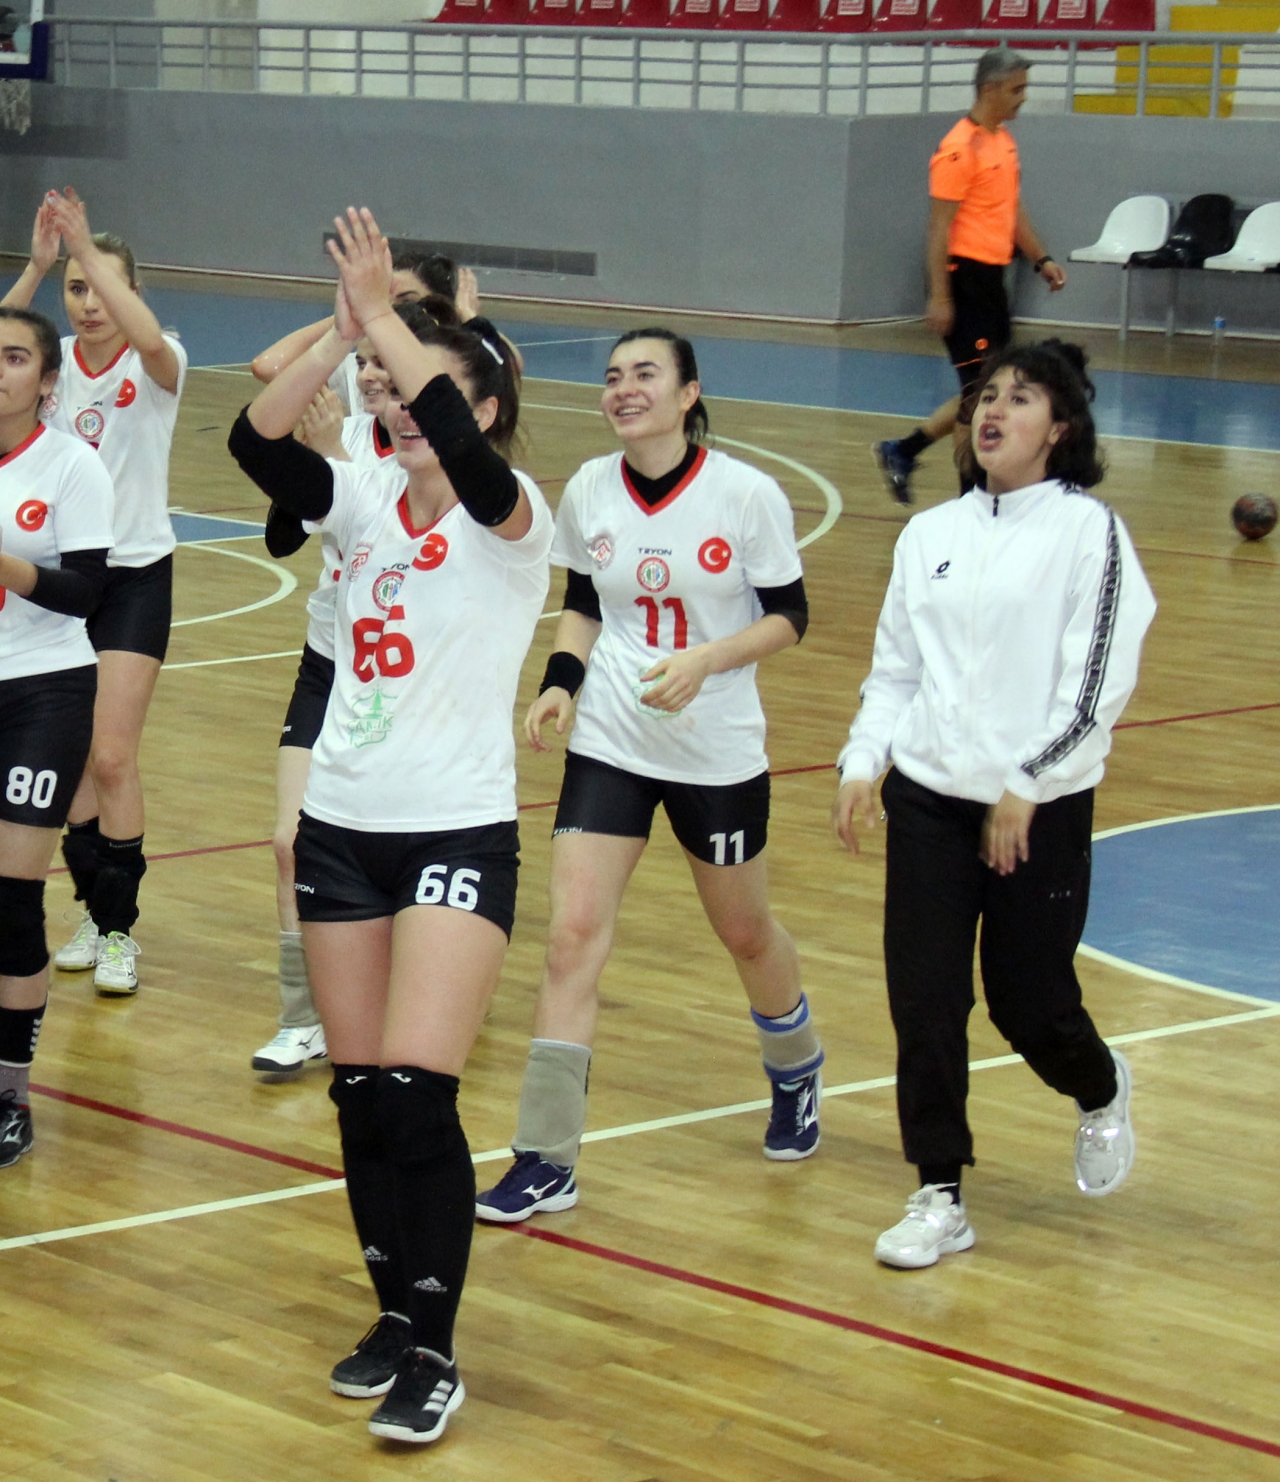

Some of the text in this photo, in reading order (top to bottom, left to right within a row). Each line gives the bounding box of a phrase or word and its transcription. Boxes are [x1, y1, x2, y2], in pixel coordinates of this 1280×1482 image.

[638, 547, 672, 557] TRYON
[352, 604, 415, 683] 66
[634, 596, 688, 650] 11
[5, 765, 58, 809] 80
[709, 829, 745, 865] 11
[415, 864, 482, 911] 66
